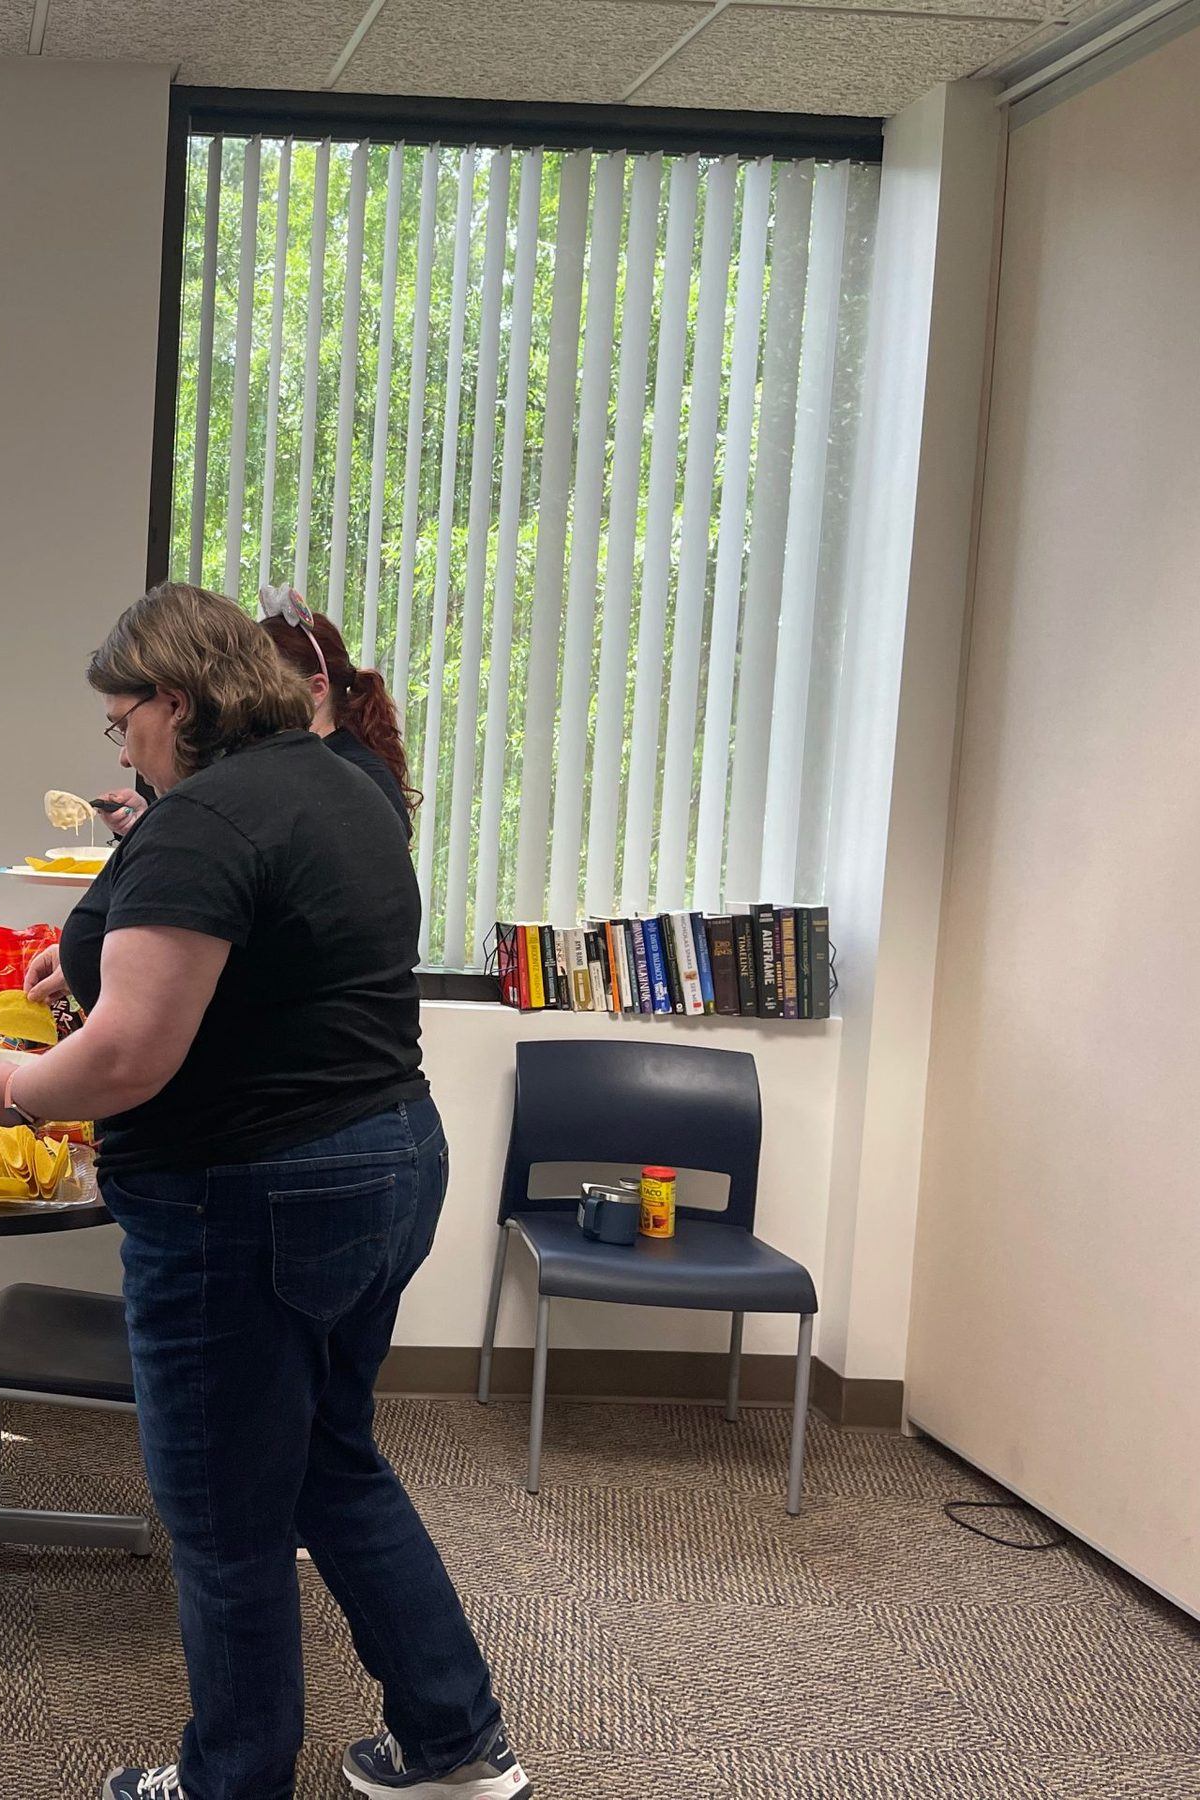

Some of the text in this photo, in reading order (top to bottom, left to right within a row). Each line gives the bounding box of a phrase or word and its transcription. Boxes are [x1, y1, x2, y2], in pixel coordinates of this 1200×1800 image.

[738, 935, 748, 977] TIMELINE
[762, 930, 775, 985] AIRFRAME
[643, 1187, 662, 1196] TACO
